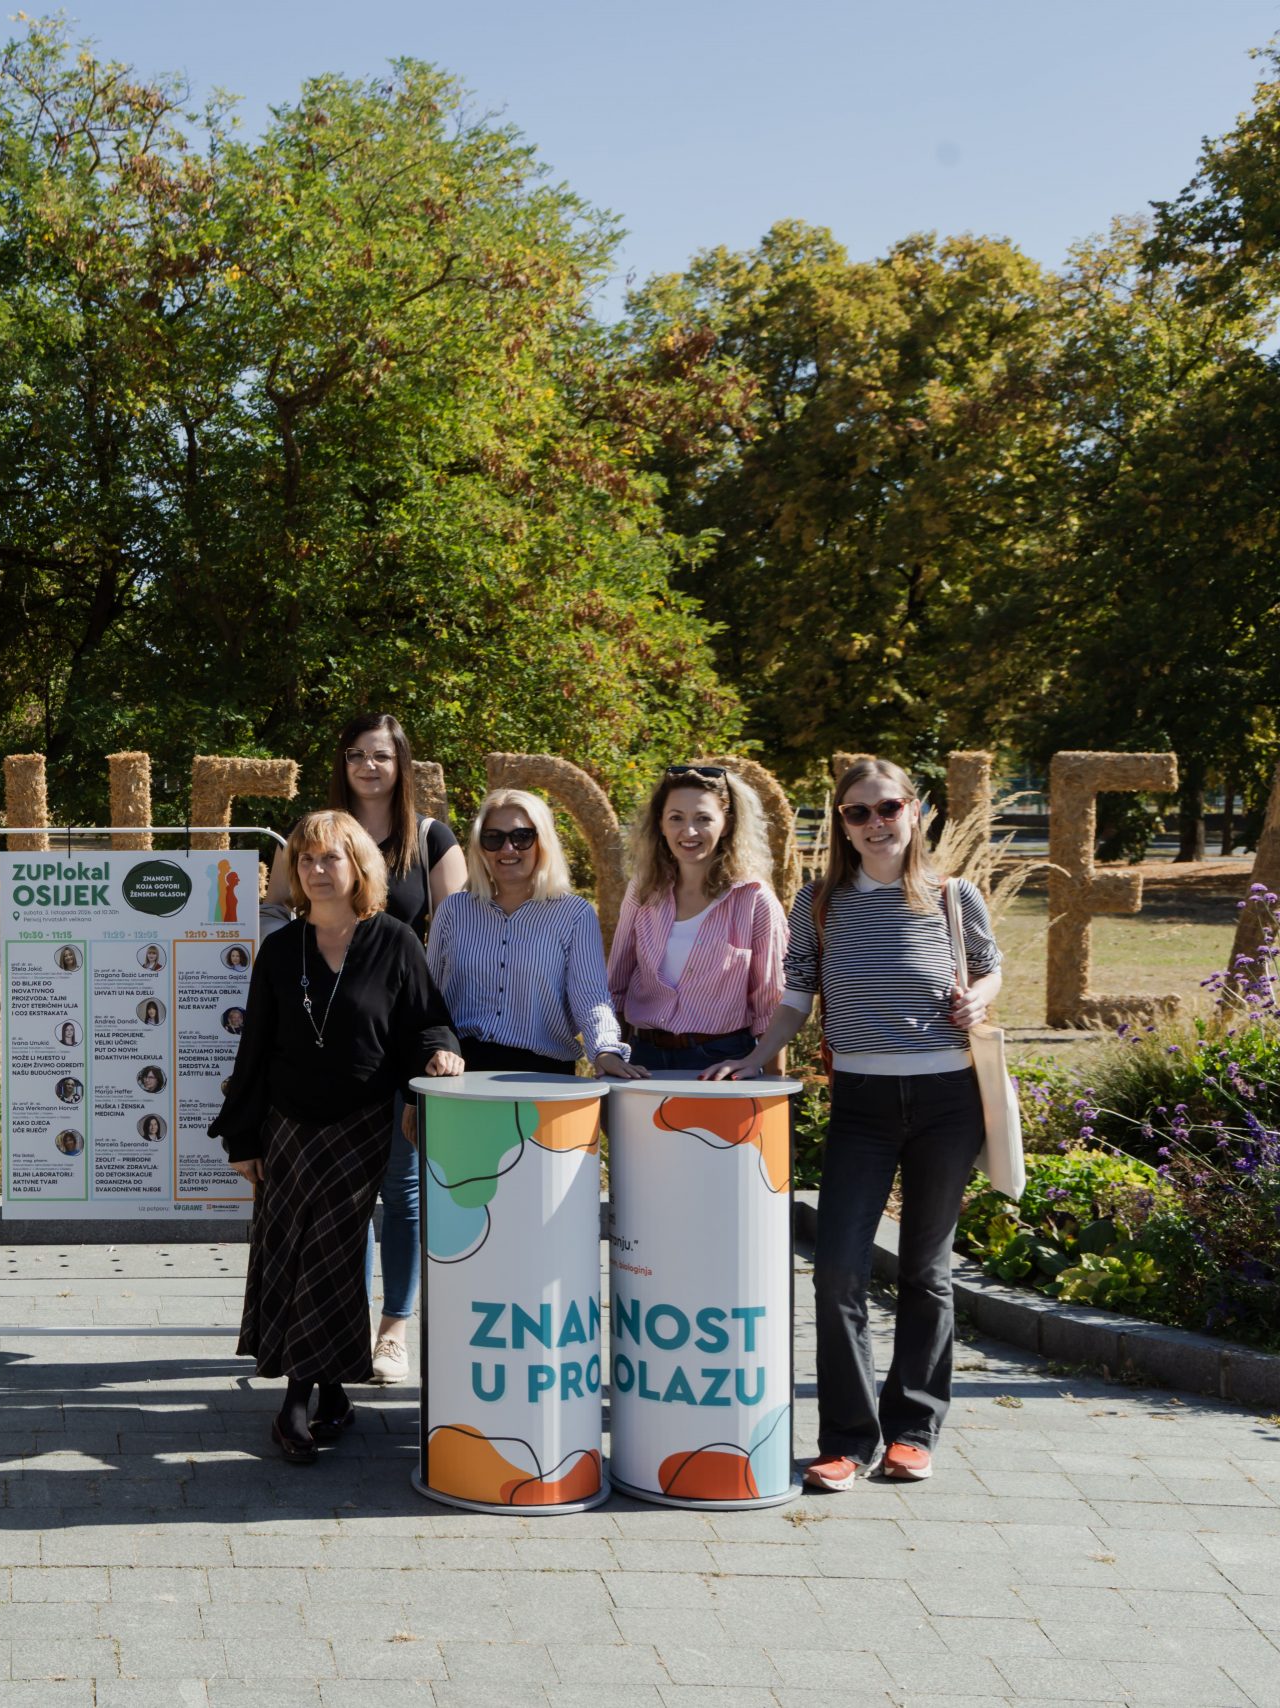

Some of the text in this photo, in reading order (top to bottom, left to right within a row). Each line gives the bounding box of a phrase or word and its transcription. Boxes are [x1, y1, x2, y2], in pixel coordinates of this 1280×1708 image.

[11, 861, 110, 881] ZUPlokal
[12, 884, 111, 907] OSIJEK
[129, 890, 158, 898] ŽENSKIM
[19, 931, 72, 939] 10:30 11:15
[610, 1291, 767, 1354] NOST
[471, 1353, 601, 1403] U PRO
[613, 1353, 766, 1407] OLAZU
